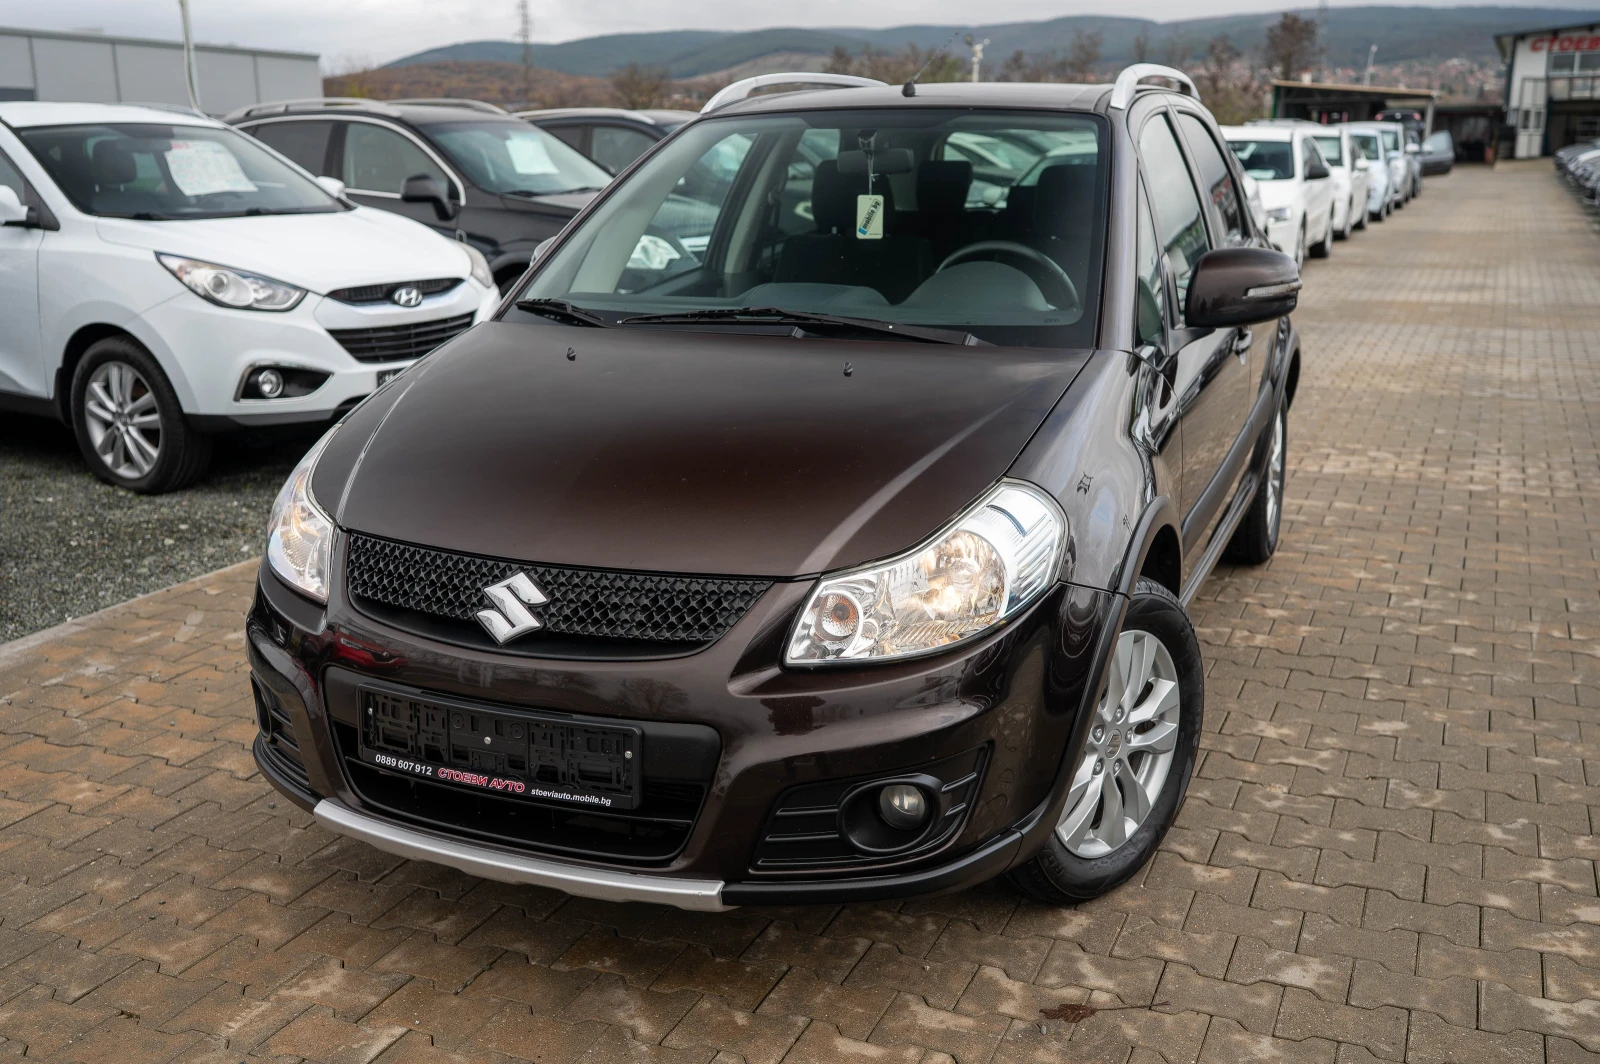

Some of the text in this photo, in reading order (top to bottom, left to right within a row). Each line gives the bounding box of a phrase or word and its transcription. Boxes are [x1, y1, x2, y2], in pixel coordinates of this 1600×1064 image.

[375, 754, 611, 806] 0889 607 912 СТОЕВИ АУТО stoeviauto.mobile.bg
